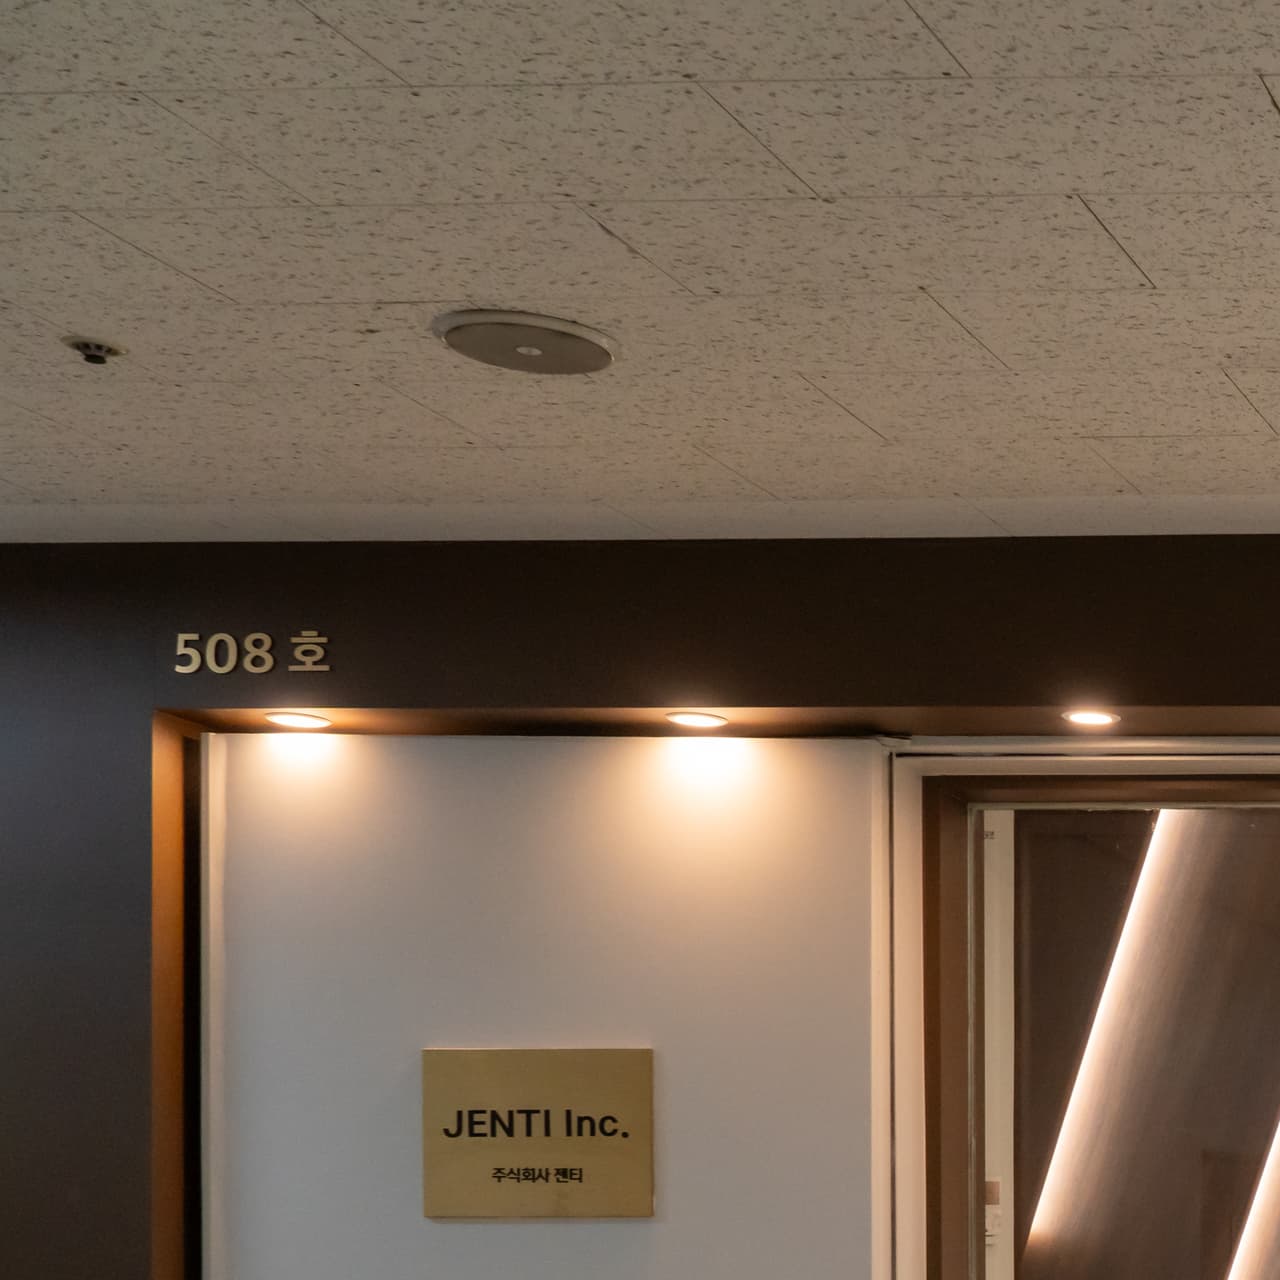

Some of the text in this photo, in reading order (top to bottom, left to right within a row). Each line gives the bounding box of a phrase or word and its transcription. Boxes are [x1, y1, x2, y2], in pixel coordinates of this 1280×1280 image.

[174, 630, 331, 674] 508 호
[442, 1109, 630, 1139] JENTI Inc.
[492, 1167, 584, 1184] 주식회사 젠티
